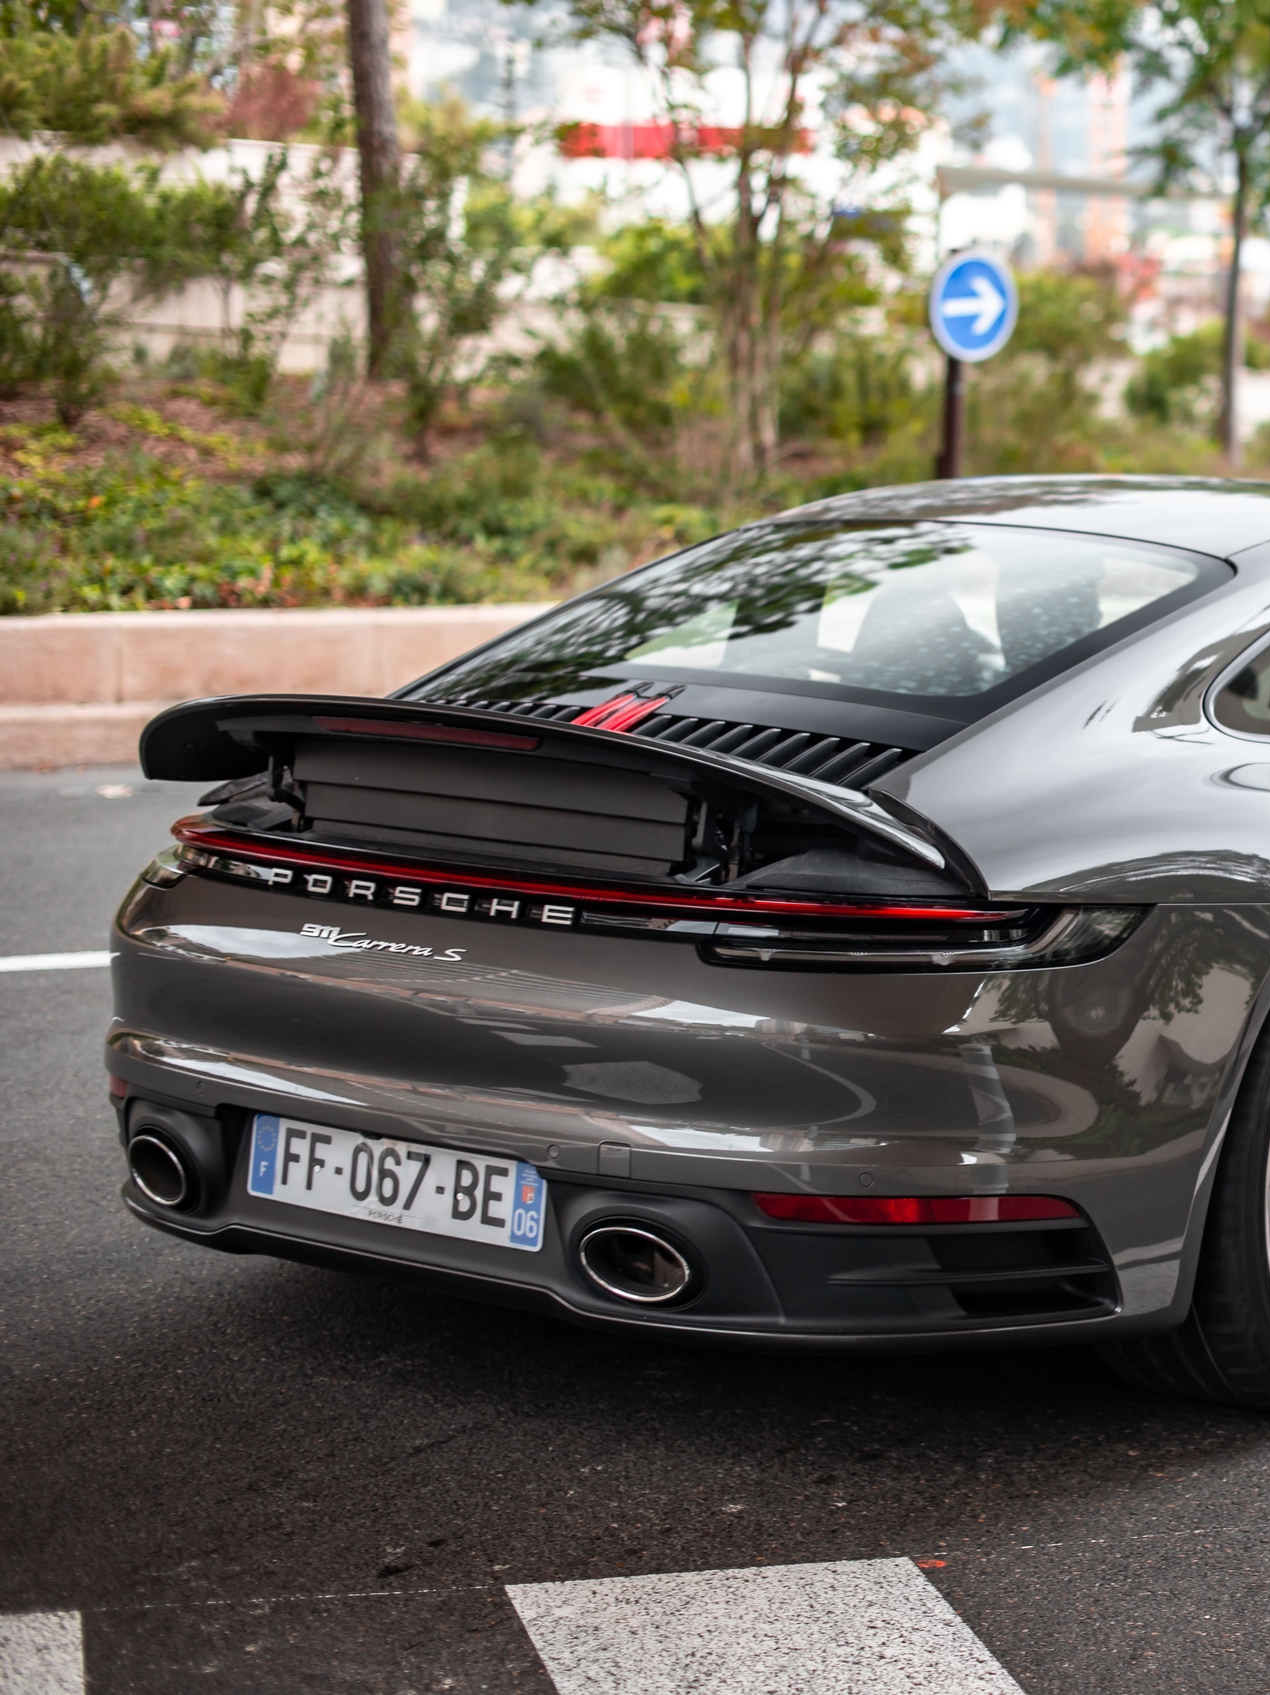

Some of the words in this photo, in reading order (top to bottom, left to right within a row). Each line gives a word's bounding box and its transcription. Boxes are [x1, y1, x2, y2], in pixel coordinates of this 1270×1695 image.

[268, 868, 576, 926] PORSCHE
[300, 923, 343, 940] 911
[326, 932, 435, 957] Carrera
[432, 948, 468, 962] S
[258, 1161, 269, 1177] F
[281, 1127, 510, 1229] FF-067-BE
[513, 1208, 539, 1238] 06
